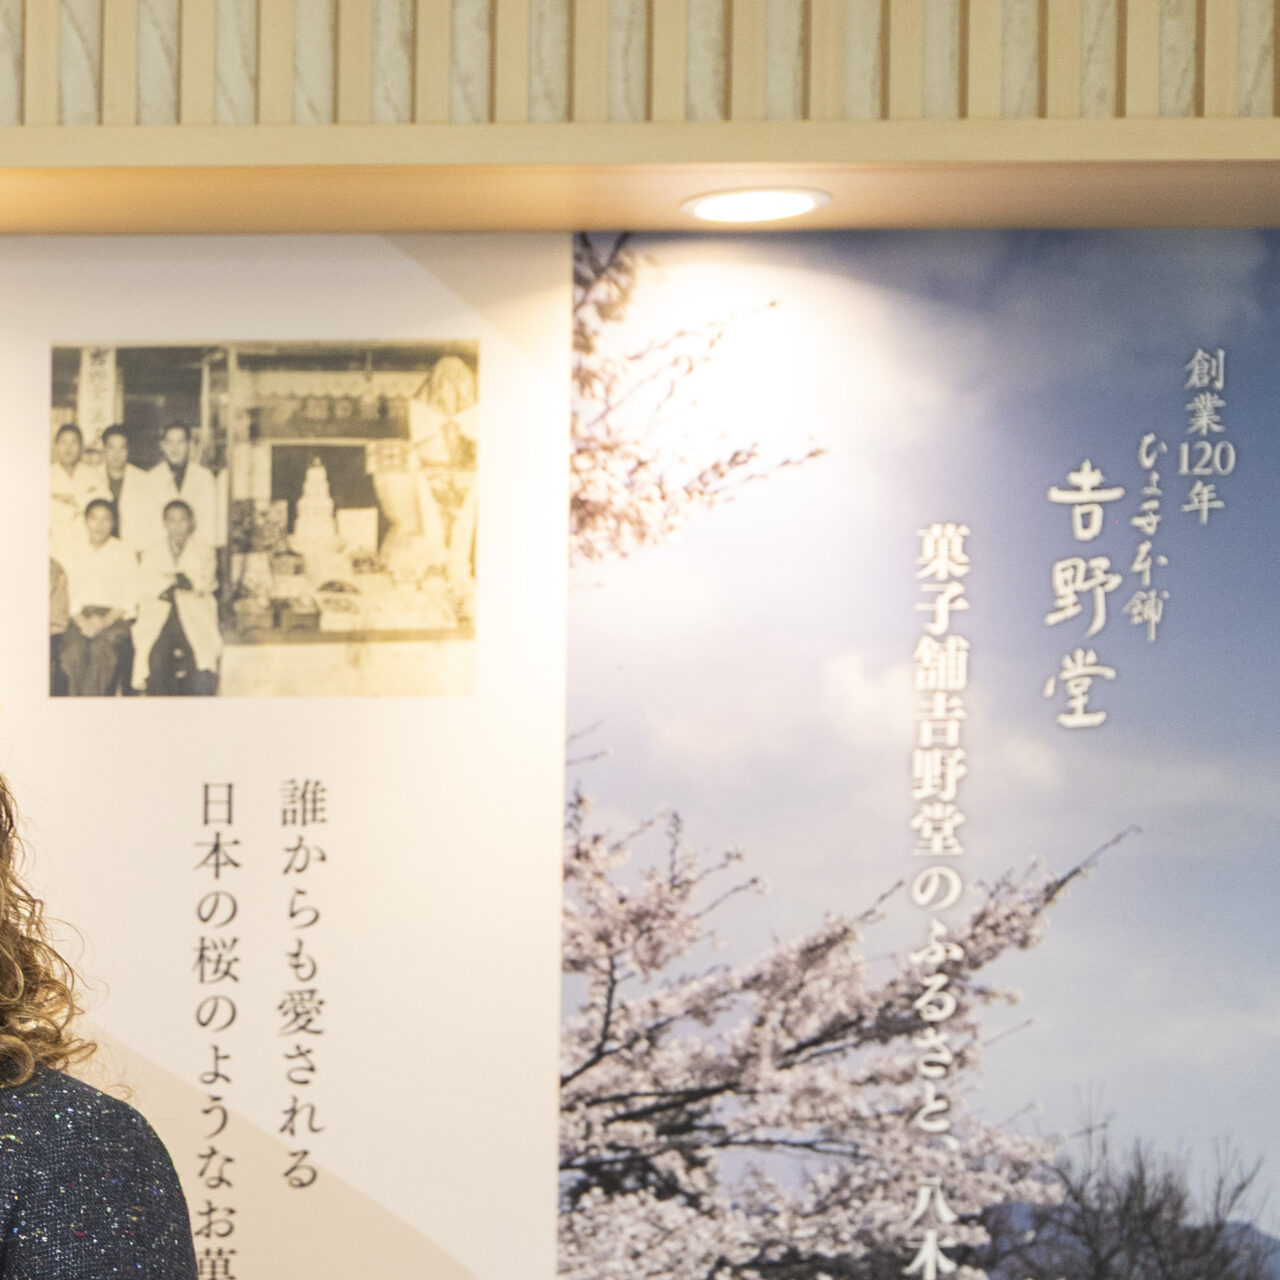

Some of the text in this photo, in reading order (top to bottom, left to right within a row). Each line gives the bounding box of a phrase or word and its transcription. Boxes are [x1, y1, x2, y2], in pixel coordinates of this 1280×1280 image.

[1178, 346, 1236, 525] 創業120年
[278, 776, 330, 1191] 誰からも愛される
